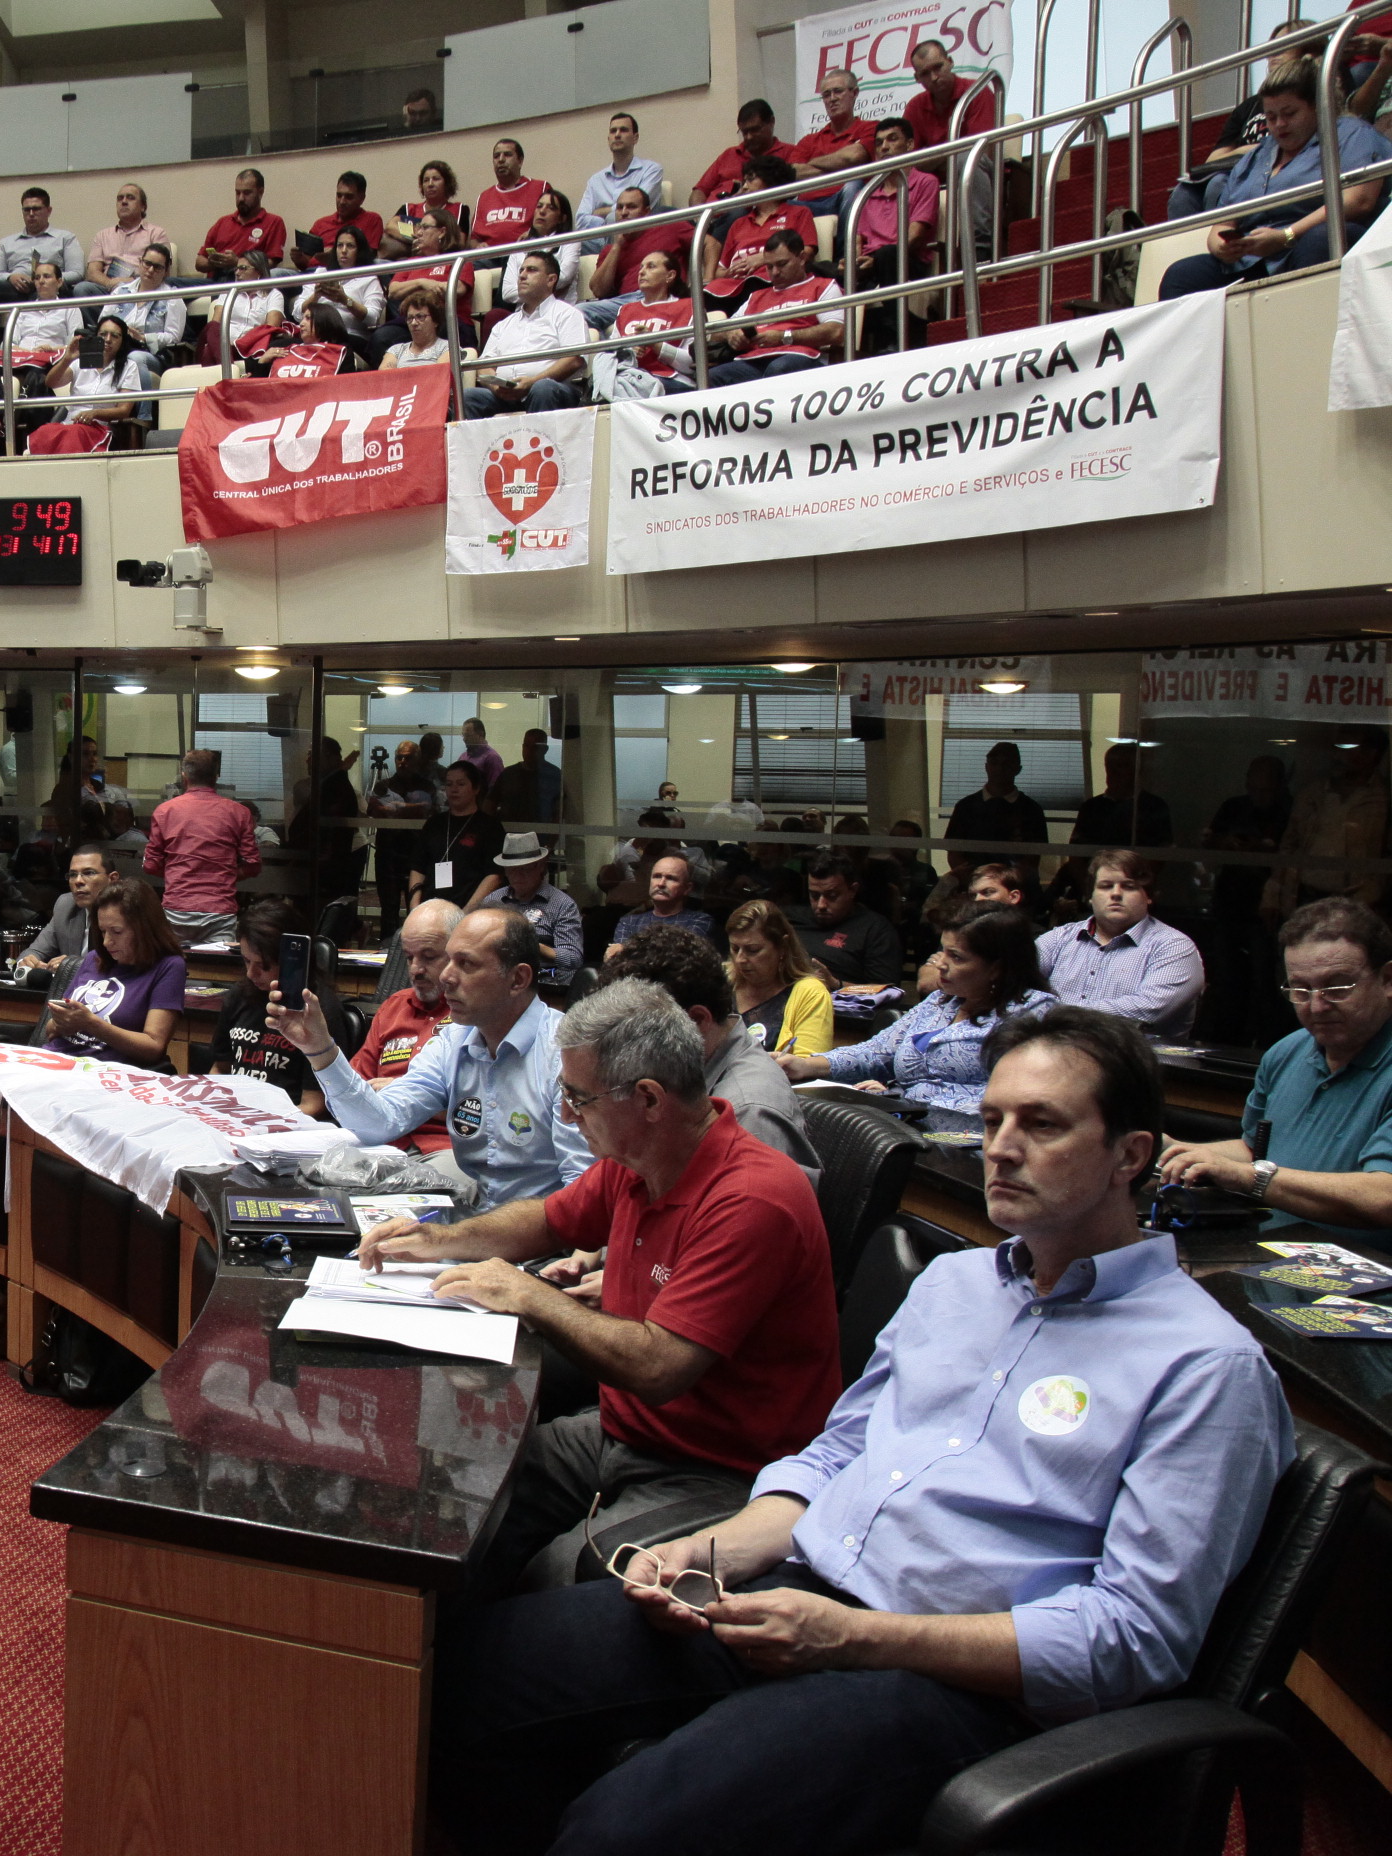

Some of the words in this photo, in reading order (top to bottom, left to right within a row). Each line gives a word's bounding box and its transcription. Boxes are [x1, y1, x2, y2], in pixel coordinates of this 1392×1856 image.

[821, 27, 846, 39] Filiada
[854, 18, 875, 31] CUT
[887, 3, 941, 22] CONTRACS
[872, 92, 894, 105] dos
[487, 206, 523, 222] CUT
[277, 364, 313, 378] CUT
[655, 399, 775, 443] SOMOS
[790, 380, 885, 424] 100%
[902, 340, 1080, 403] CONTRA
[1096, 327, 1125, 368] A
[386, 384, 417, 463] BRASIL
[218, 396, 394, 484] CUT
[630, 448, 793, 500] REFORMA
[808, 438, 858, 477] DA
[872, 381, 1158, 468] PREVIDÊNCIA
[1070, 453, 1132, 479] FECESC
[213, 490, 260, 499] CENTRAL
[261, 484, 292, 497] ÚNICA
[293, 479, 314, 490] DOS
[315, 462, 403, 484] TRABALHADORES
[646, 515, 711, 535] SINDICATOS
[715, 511, 739, 526] DOS
[743, 497, 856, 523] TRABALHADORES
[859, 495, 879, 509] NO
[883, 482, 954, 506] COMÉRCIO
[959, 479, 968, 494] E
[973, 468, 1050, 492] SERVIÇOS
[1055, 470, 1064, 481] e
[11, 502, 28, 531] 9
[36, 501, 72, 531] 49
[522, 530, 566, 548] CUT
[264, 1051, 290, 1070] FAZ
[457, 1110, 465, 1118] 65
[465, 1114, 480, 1124] anos
[464, 1099, 481, 1110] NÃO
